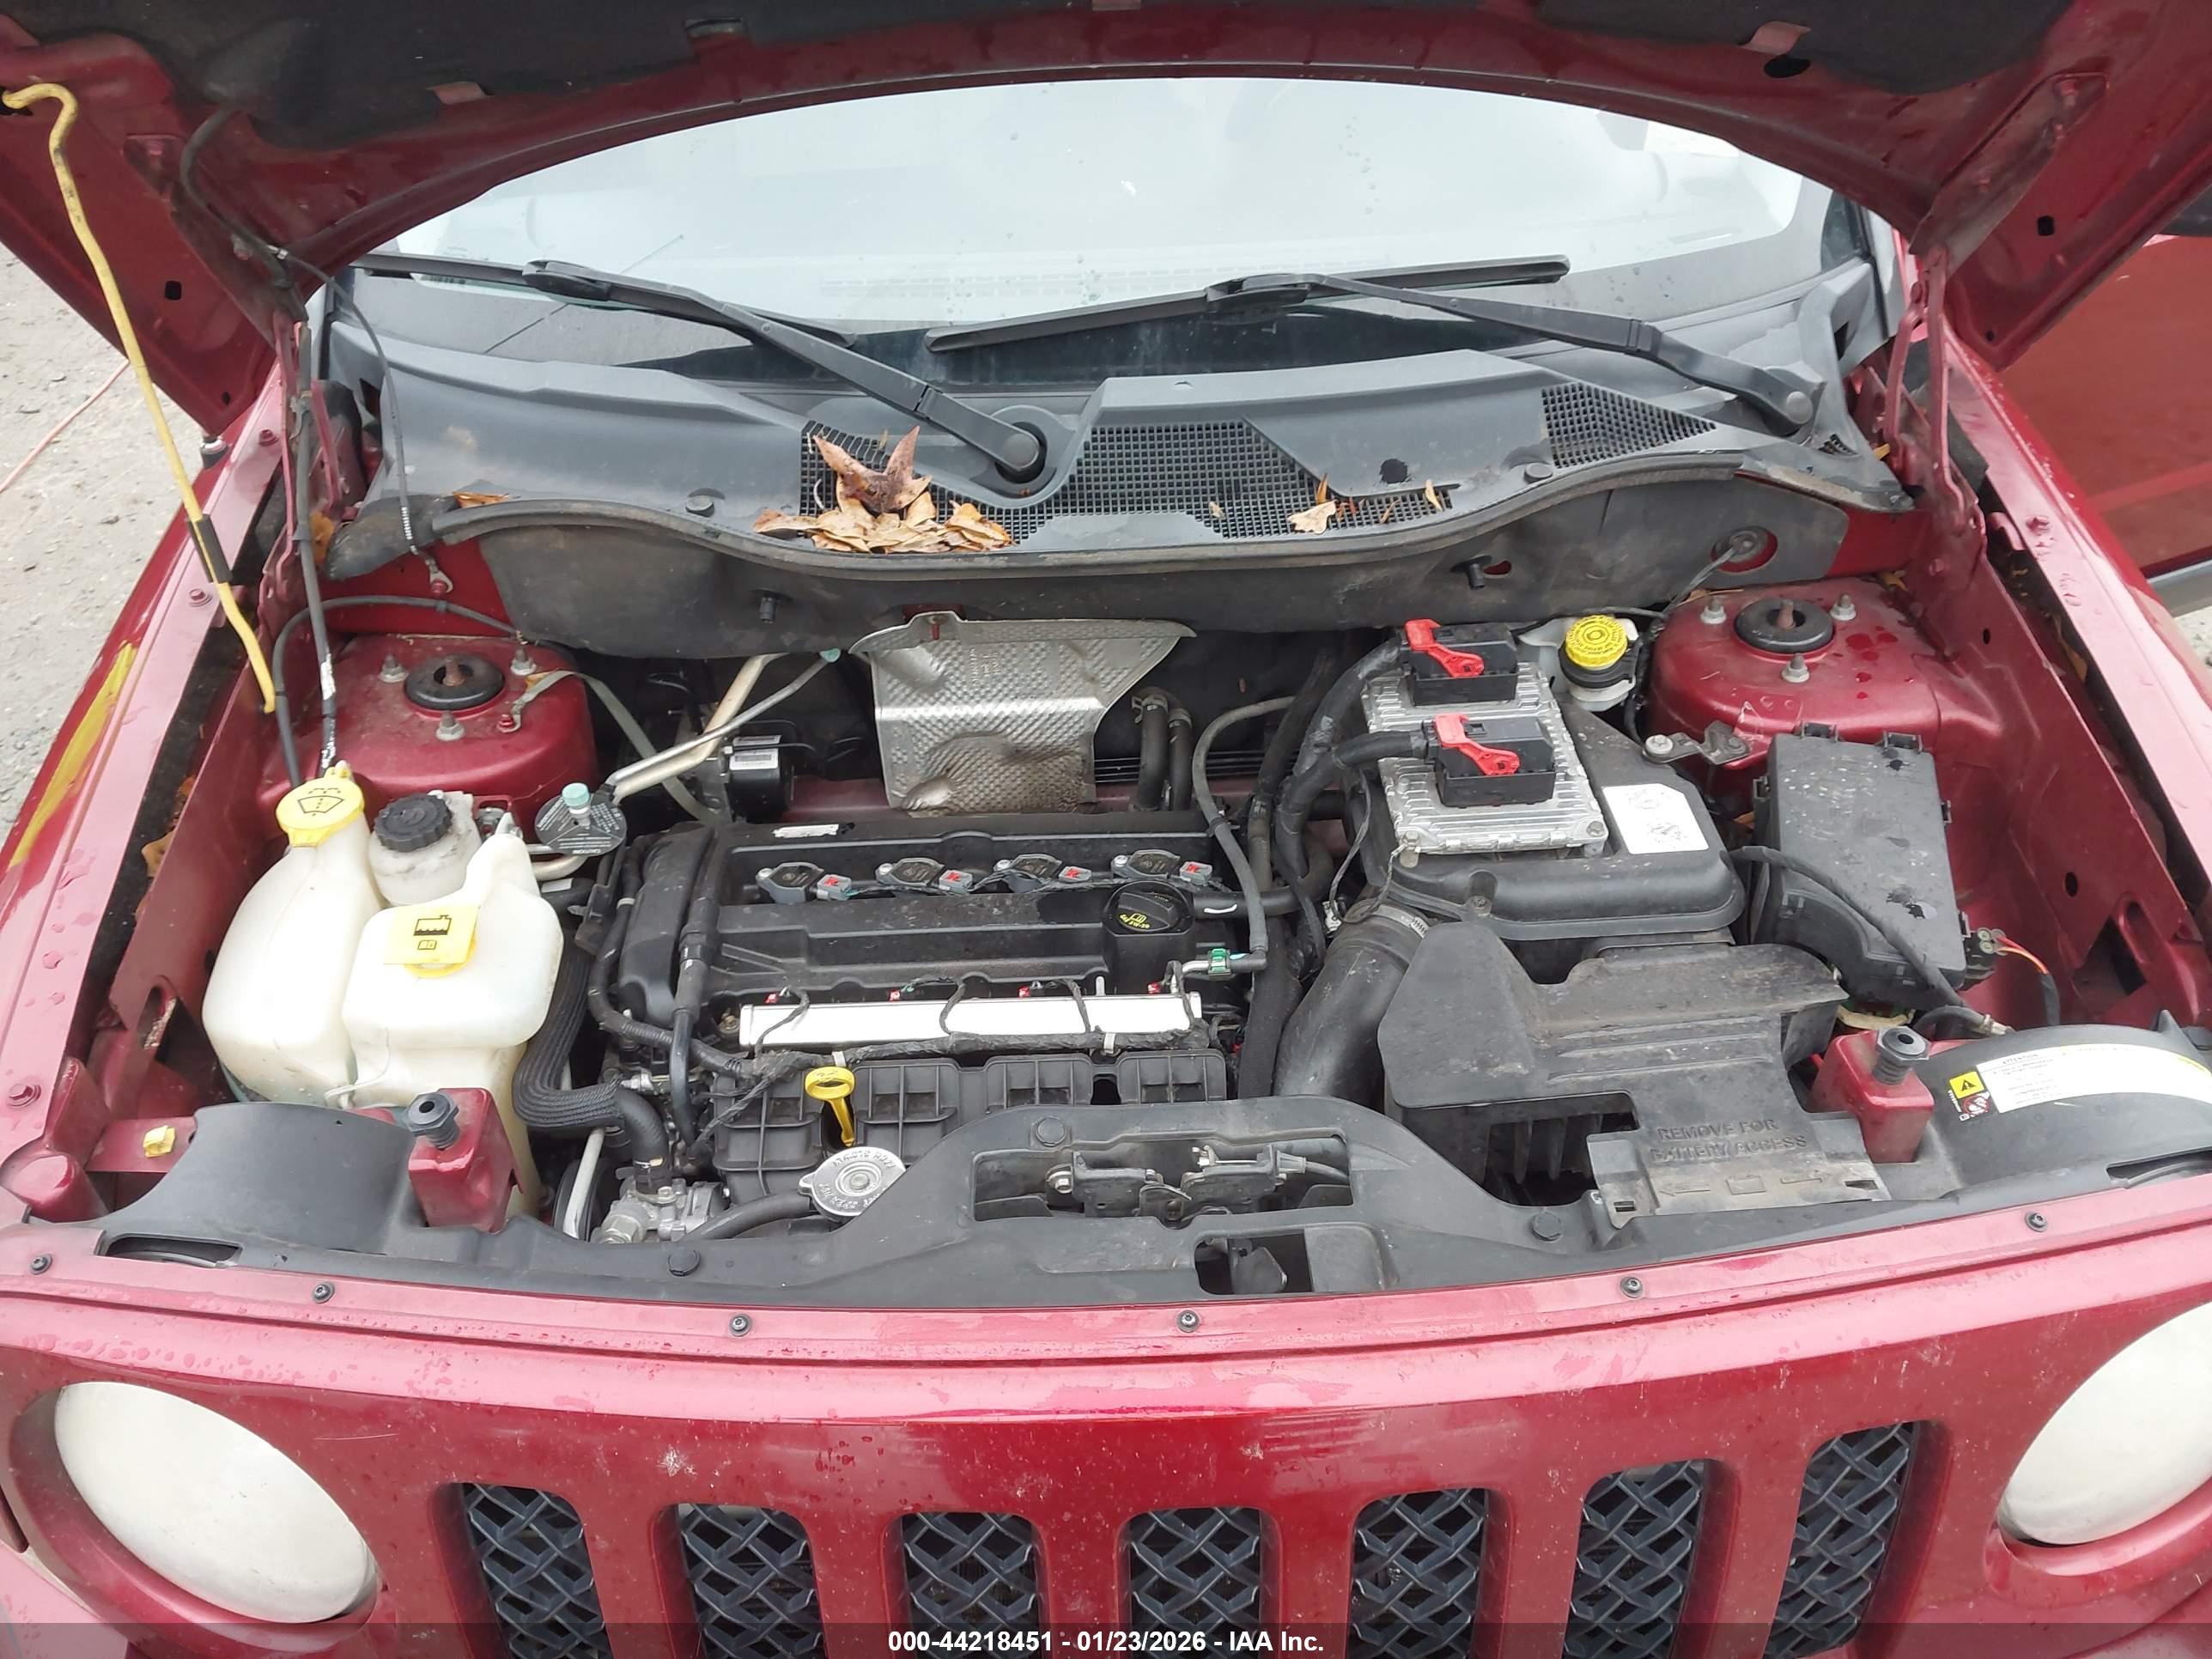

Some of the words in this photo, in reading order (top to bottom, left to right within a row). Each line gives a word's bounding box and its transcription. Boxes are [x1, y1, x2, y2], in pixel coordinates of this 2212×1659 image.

[1657, 1122, 1735, 1141] REMOVE
[1738, 1118, 1779, 1133] FOR
[1650, 1139, 1731, 1163] BATTERY
[1735, 1134, 1808, 1157] ACCESS
